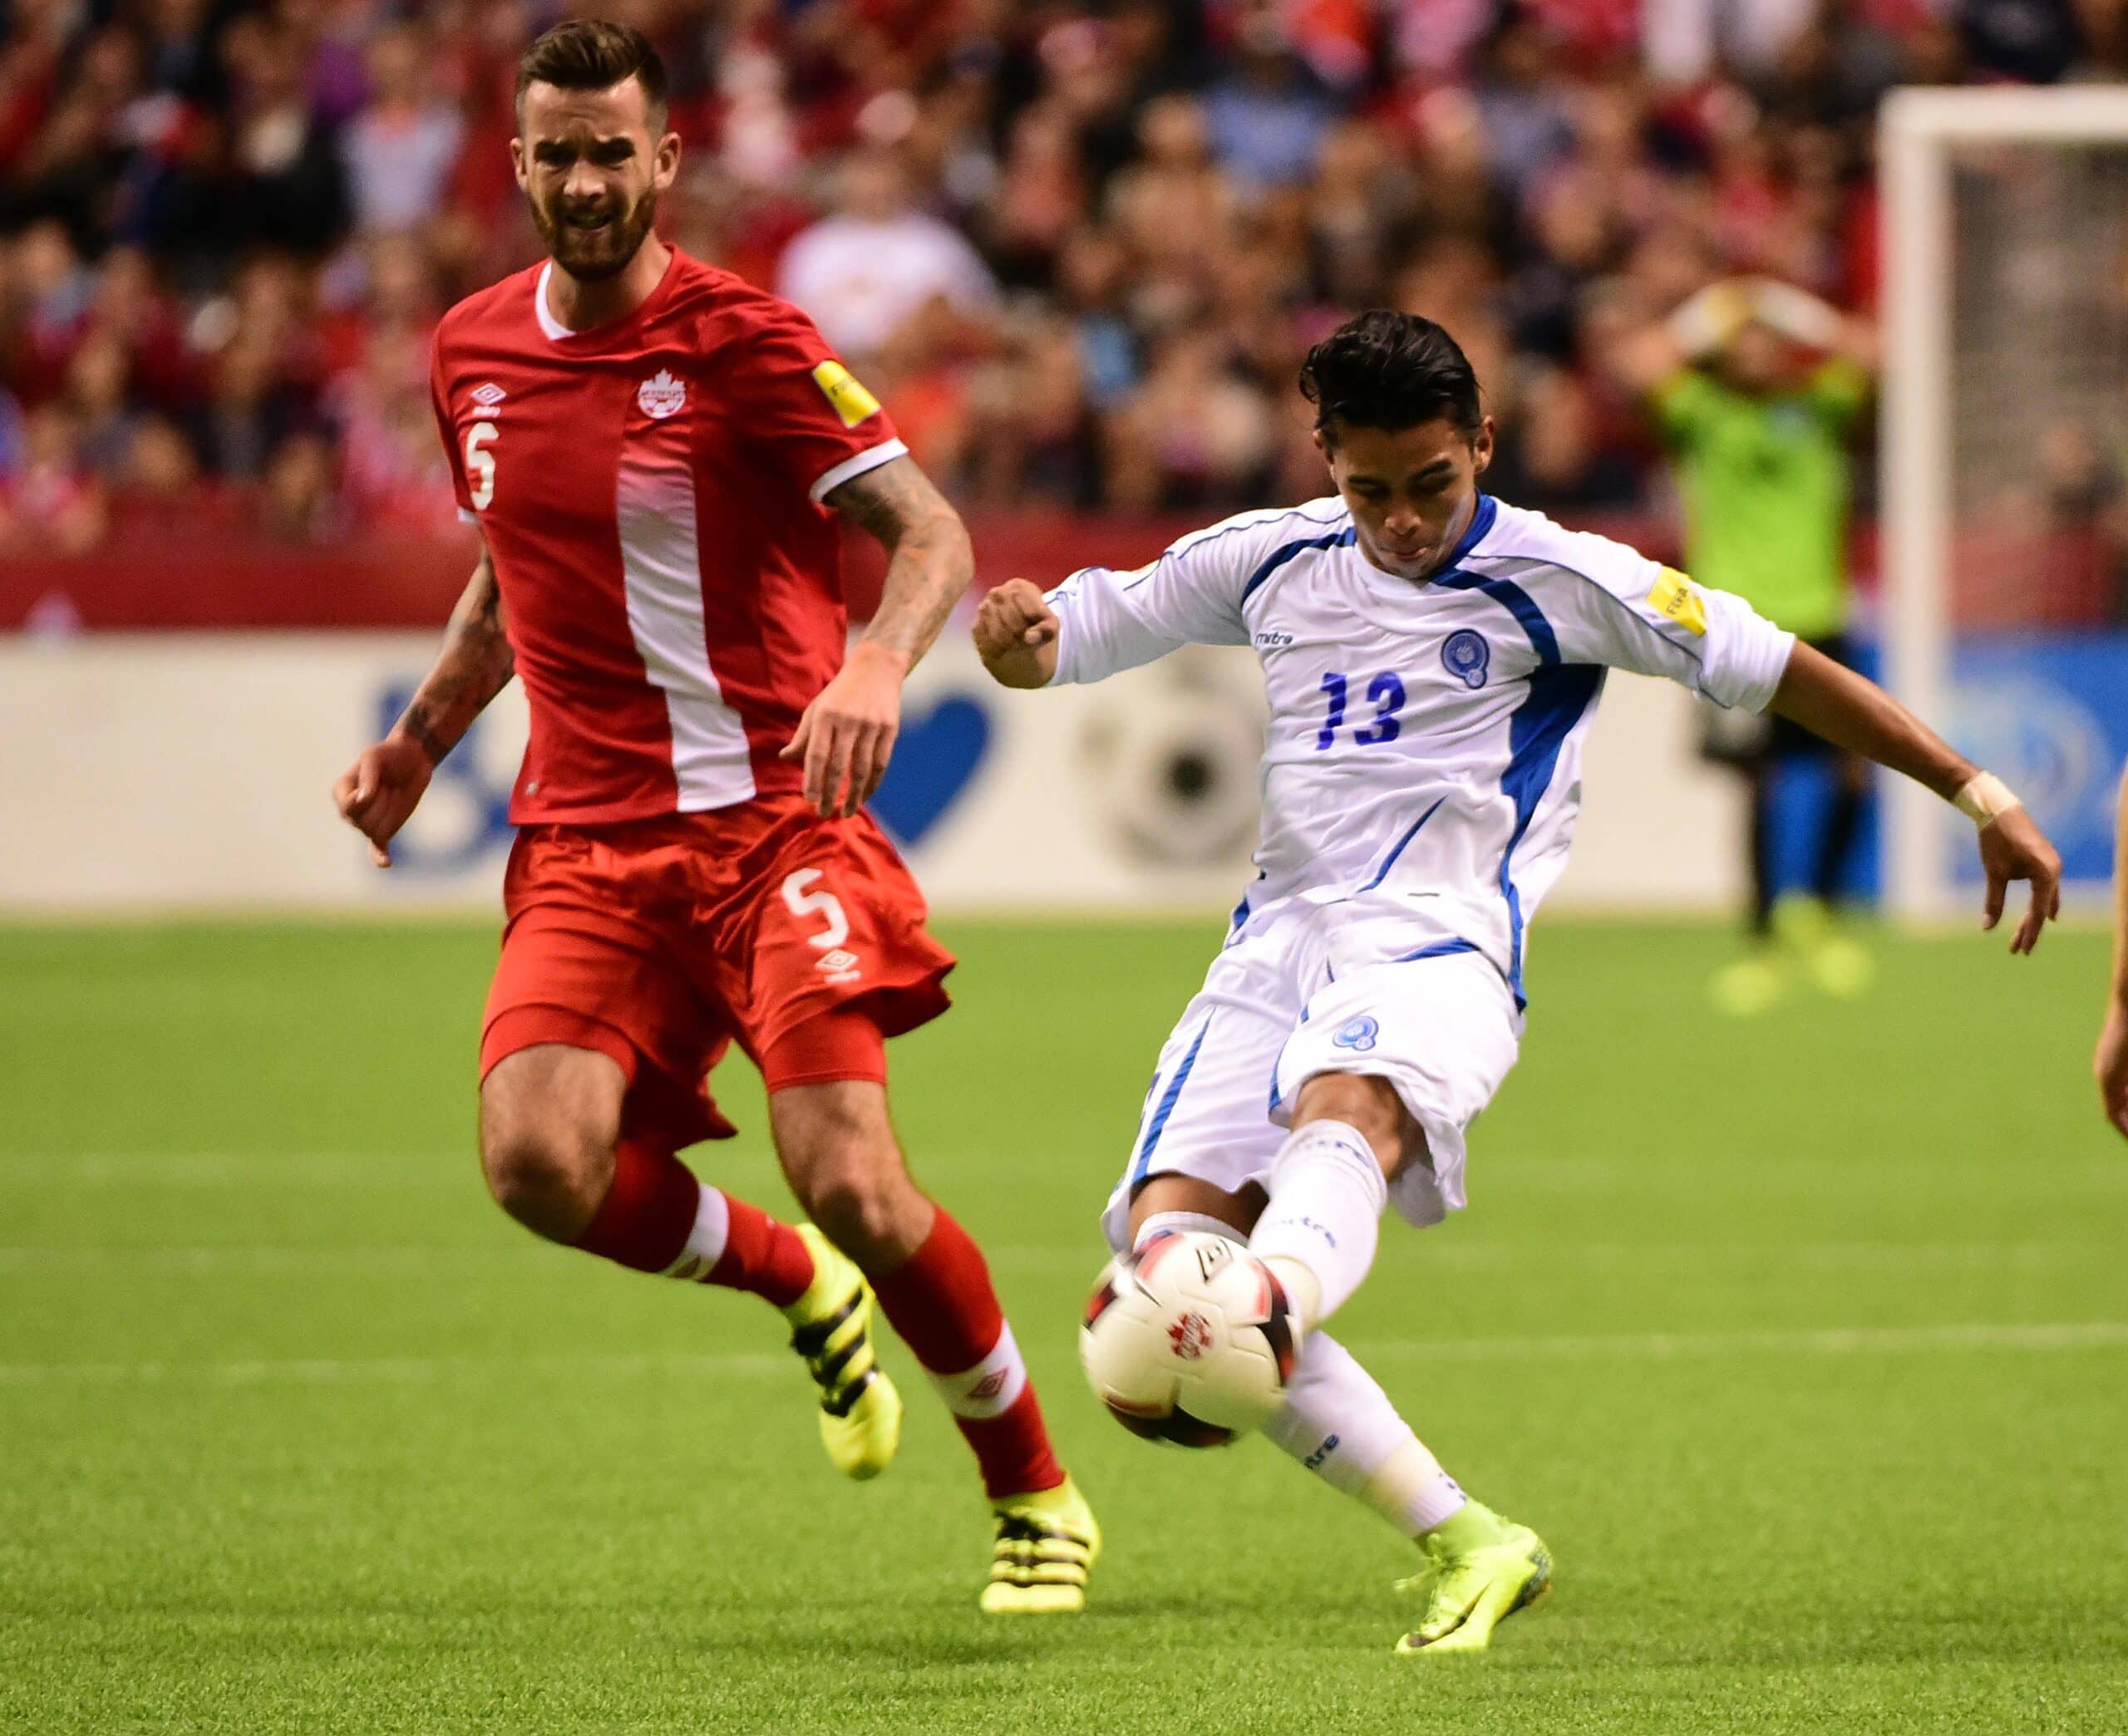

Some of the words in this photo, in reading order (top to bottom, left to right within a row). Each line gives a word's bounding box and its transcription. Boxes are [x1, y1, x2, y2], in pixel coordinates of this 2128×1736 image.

[466, 420, 499, 510] 5
[1255, 631, 1294, 645] mitre
[1316, 671, 1406, 750] 13
[780, 867, 849, 949] 5
